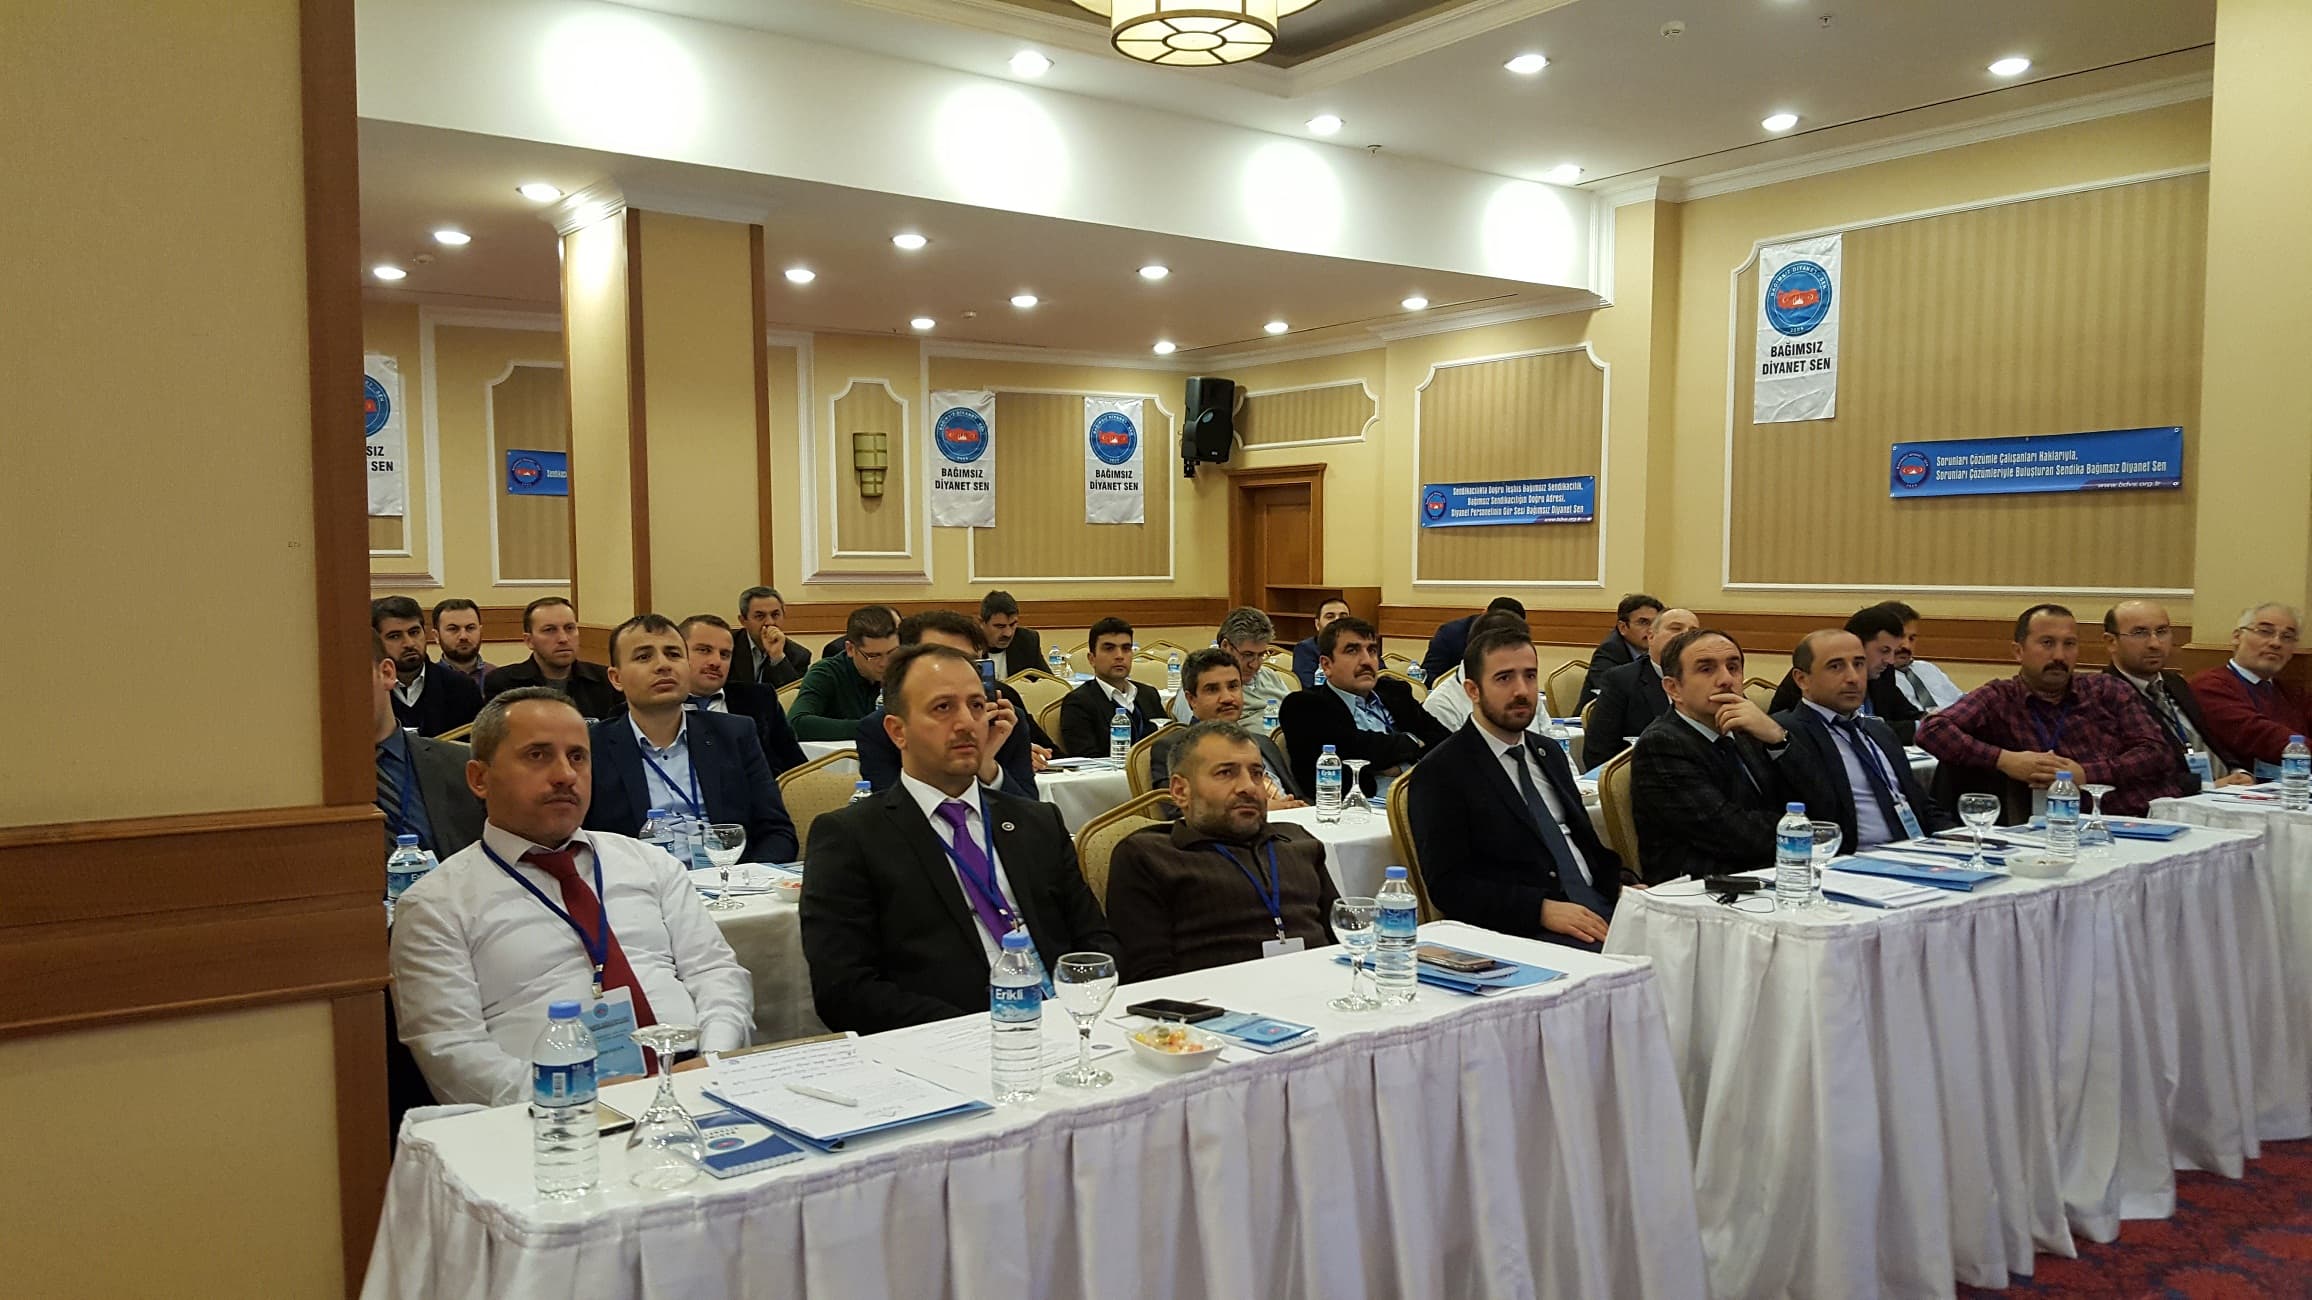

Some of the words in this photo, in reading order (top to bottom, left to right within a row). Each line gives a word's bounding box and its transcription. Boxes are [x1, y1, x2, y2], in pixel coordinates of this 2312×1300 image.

[1770, 341, 1823, 357] BAĞIMSIZ
[1762, 360, 1806, 375] DİYANET
[1810, 357, 1831, 371] SEN
[1936, 456, 1968, 467] Sorunları
[1969, 453, 1998, 465] Çözümle
[2000, 451, 2037, 465] Çalışanları
[371, 461, 394, 472] SEN
[941, 467, 983, 478] BAĞIMSIZ
[1936, 469, 1968, 481] Sorunları
[2015, 465, 2054, 478] Buluşturan
[2055, 463, 2084, 475] Sendika
[2086, 462, 2120, 475] Bağımsız
[2121, 461, 2150, 473] Diyanet
[2152, 460, 2167, 472] Sen
[1095, 468, 1133, 479] BAĞIMSIZ
[935, 479, 971, 491] DİYANET
[973, 482, 990, 491] SEN
[1089, 480, 1121, 490] DİYANET
[1123, 482, 1139, 491] SEN
[995, 988, 1024, 1000] Erikli
